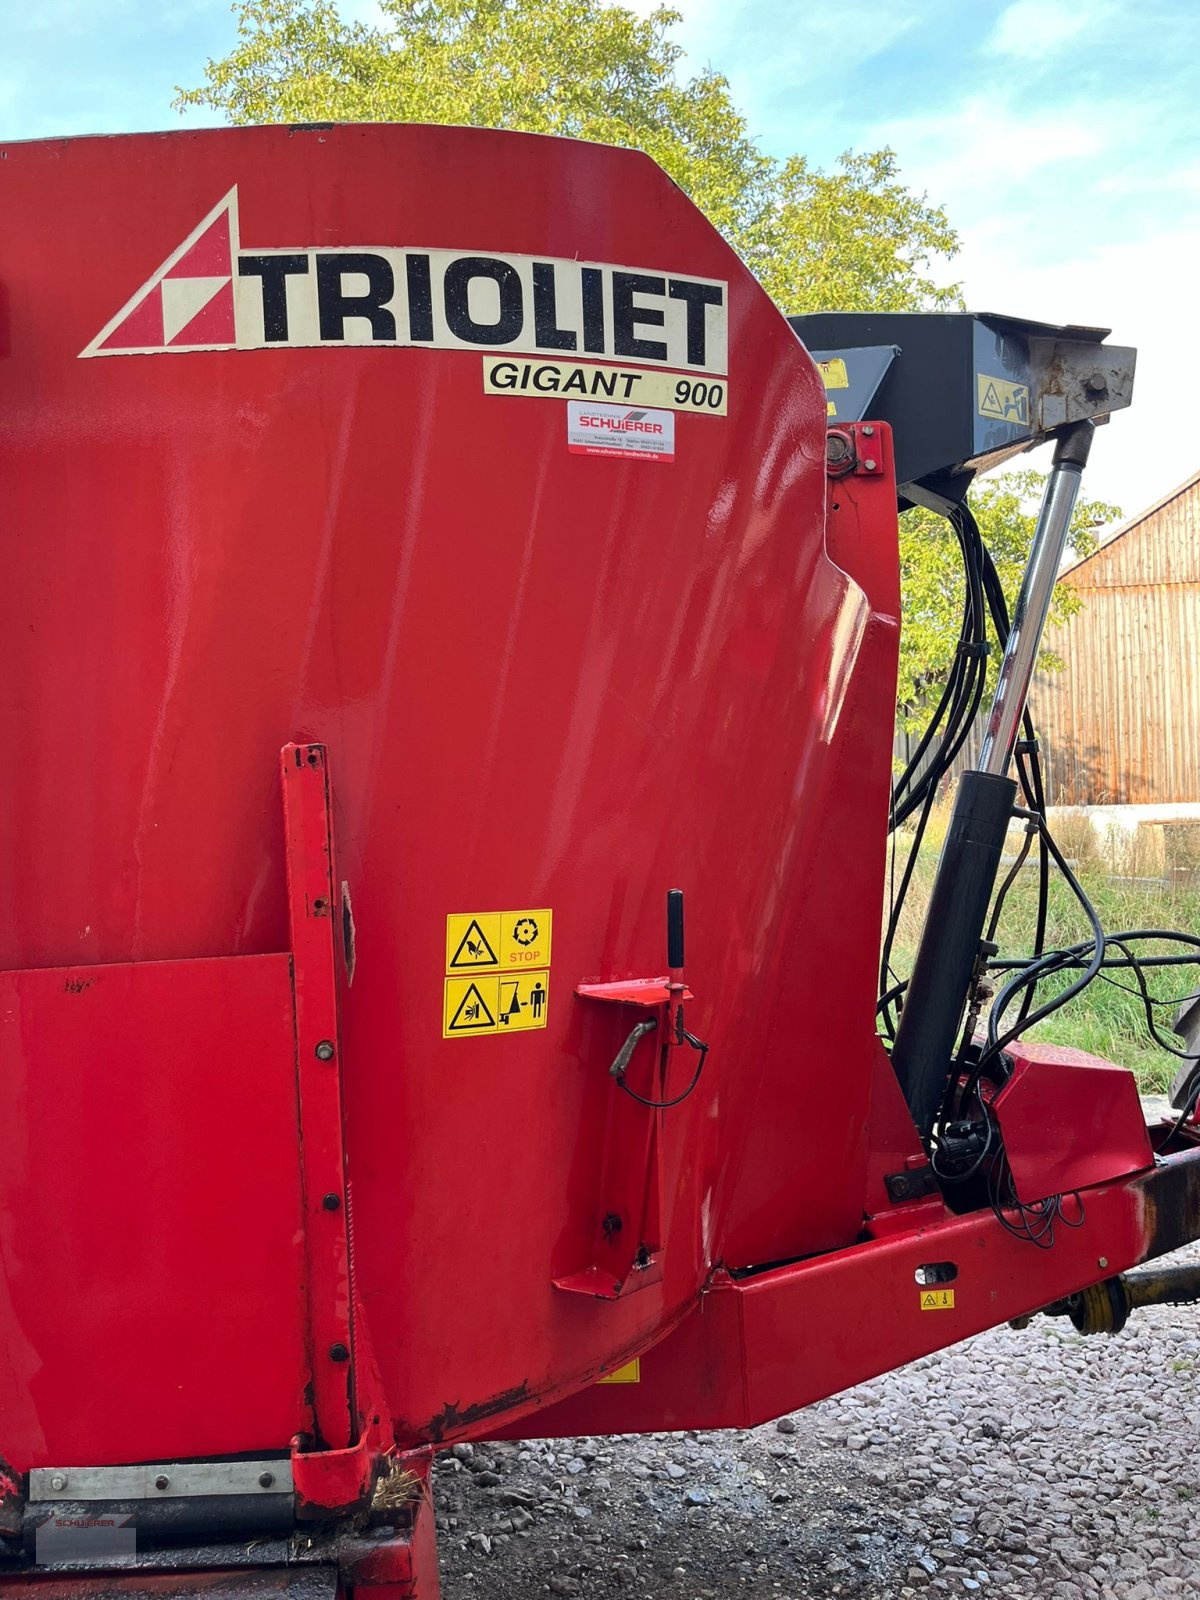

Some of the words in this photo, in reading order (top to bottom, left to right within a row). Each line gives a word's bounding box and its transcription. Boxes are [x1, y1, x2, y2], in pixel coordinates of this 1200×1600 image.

[238, 253, 723, 366] TRIOLIET
[489, 362, 642, 398] GIGANT
[674, 379, 724, 409] 900
[510, 951, 540, 962] STOP
